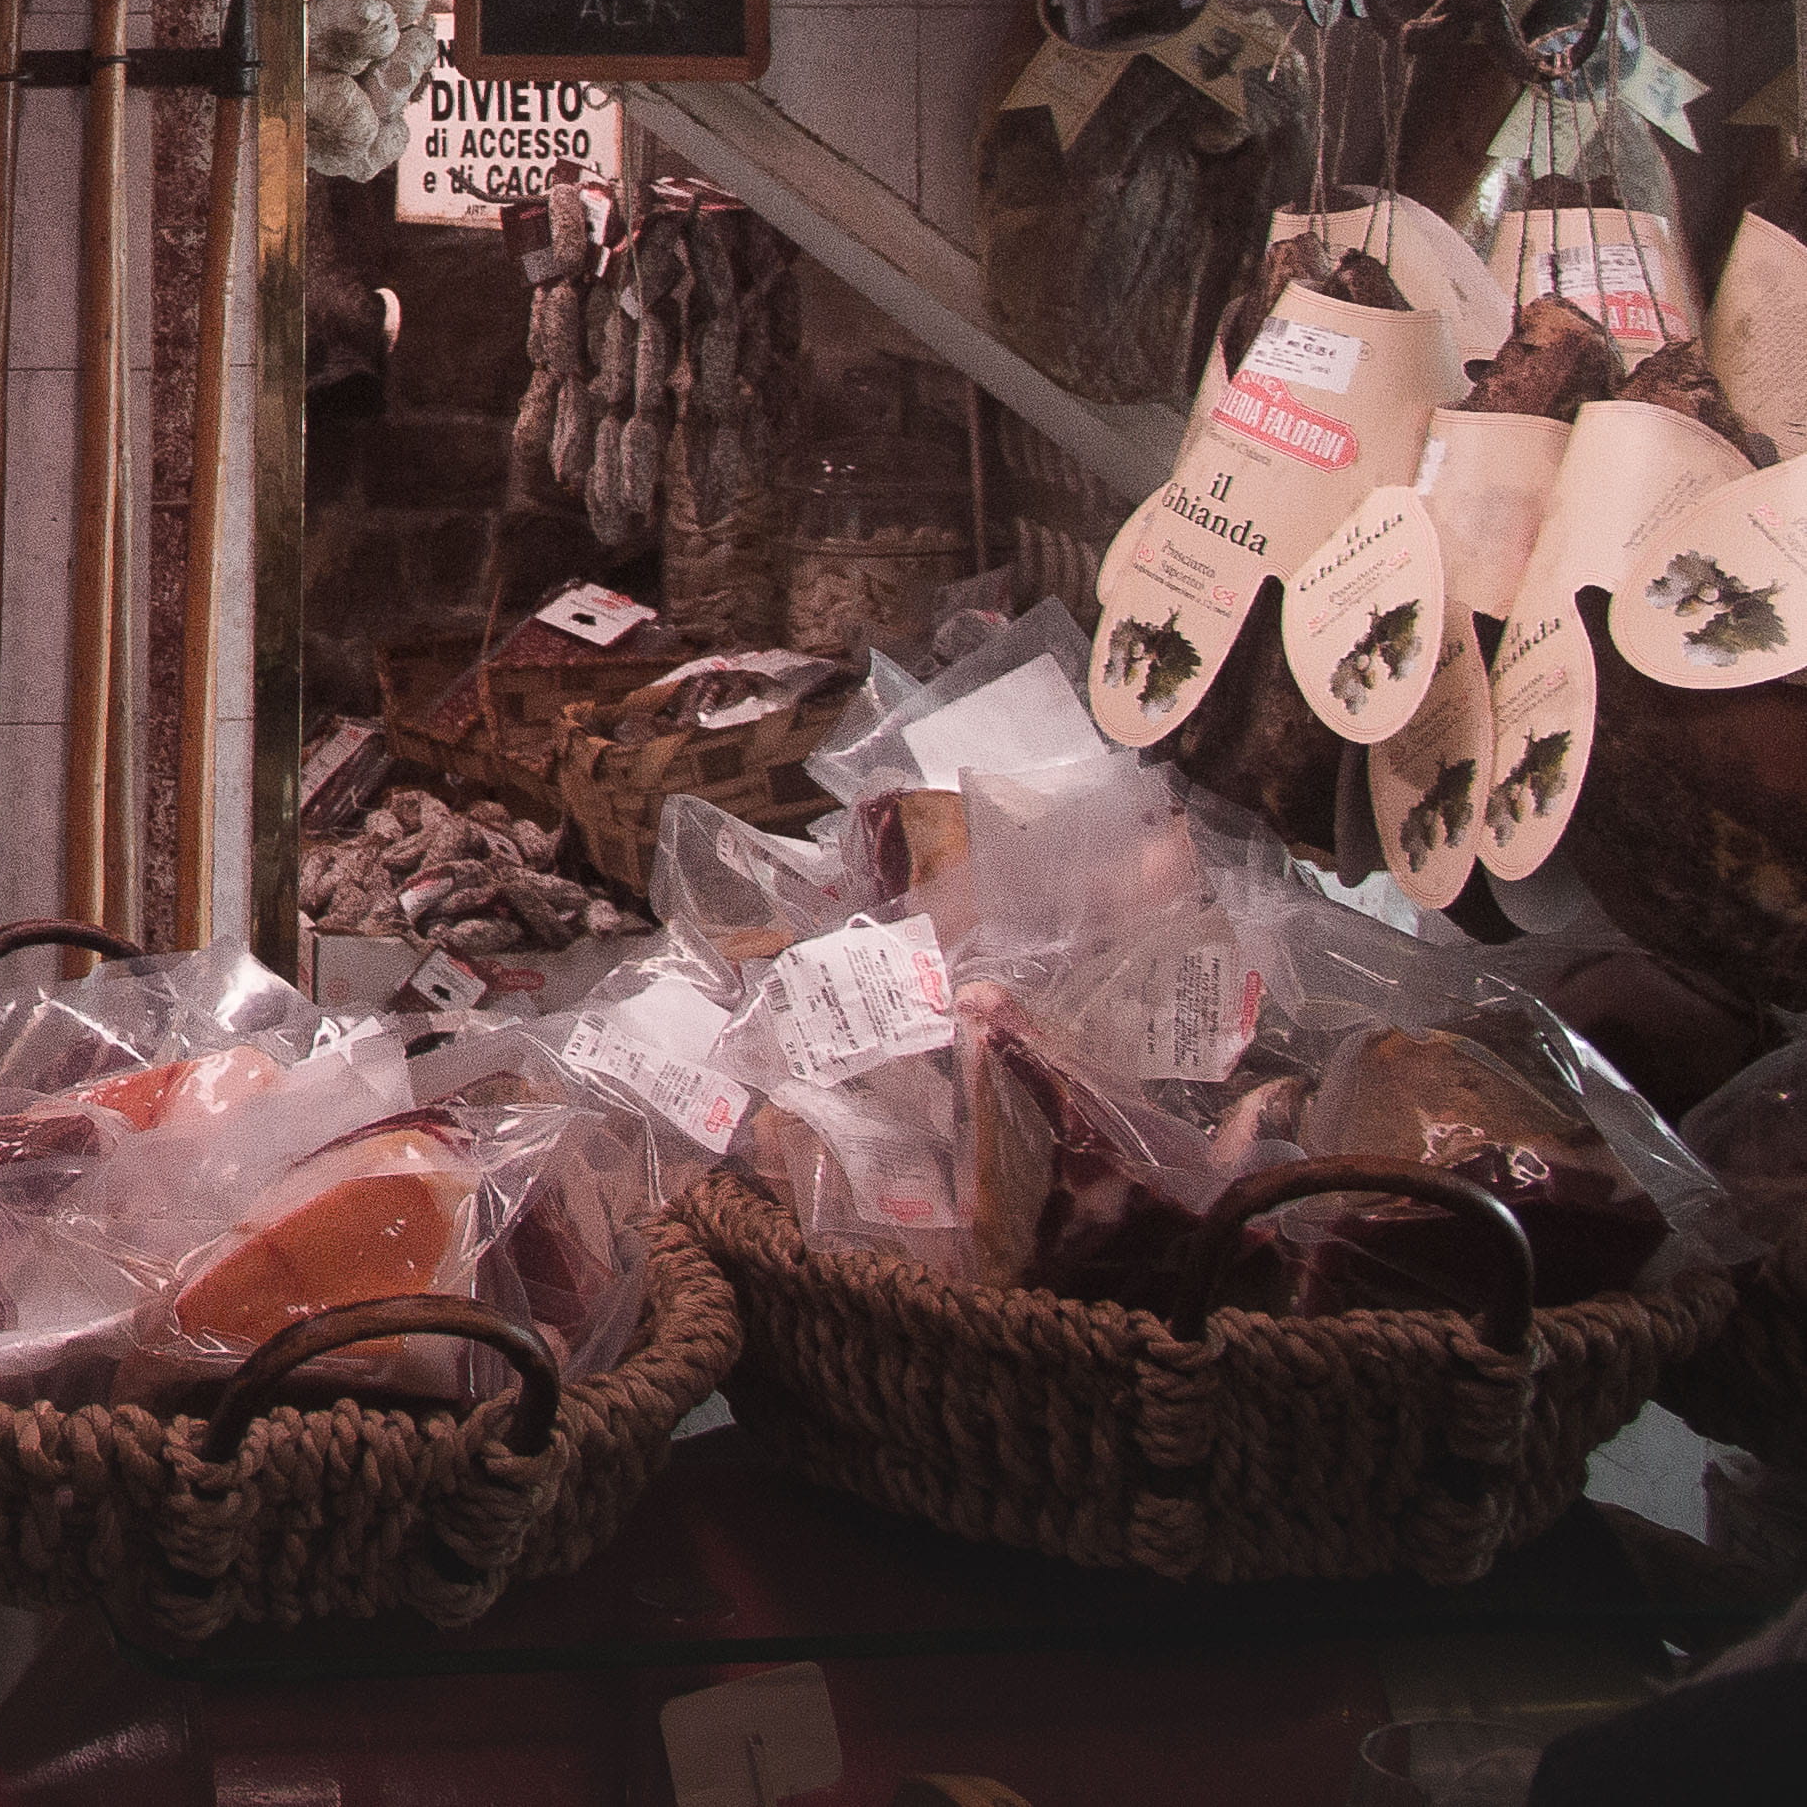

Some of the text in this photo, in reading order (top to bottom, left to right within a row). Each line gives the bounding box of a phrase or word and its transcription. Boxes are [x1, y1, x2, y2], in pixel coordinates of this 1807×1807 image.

[430, 80, 584, 123] DIVIETO
[425, 127, 592, 160] di ACCESSO
[423, 169, 438, 194] e
[1259, 405, 1347, 464] FALORNI
[1208, 472, 1234, 503] il
[1161, 482, 1269, 556] Ghianda
